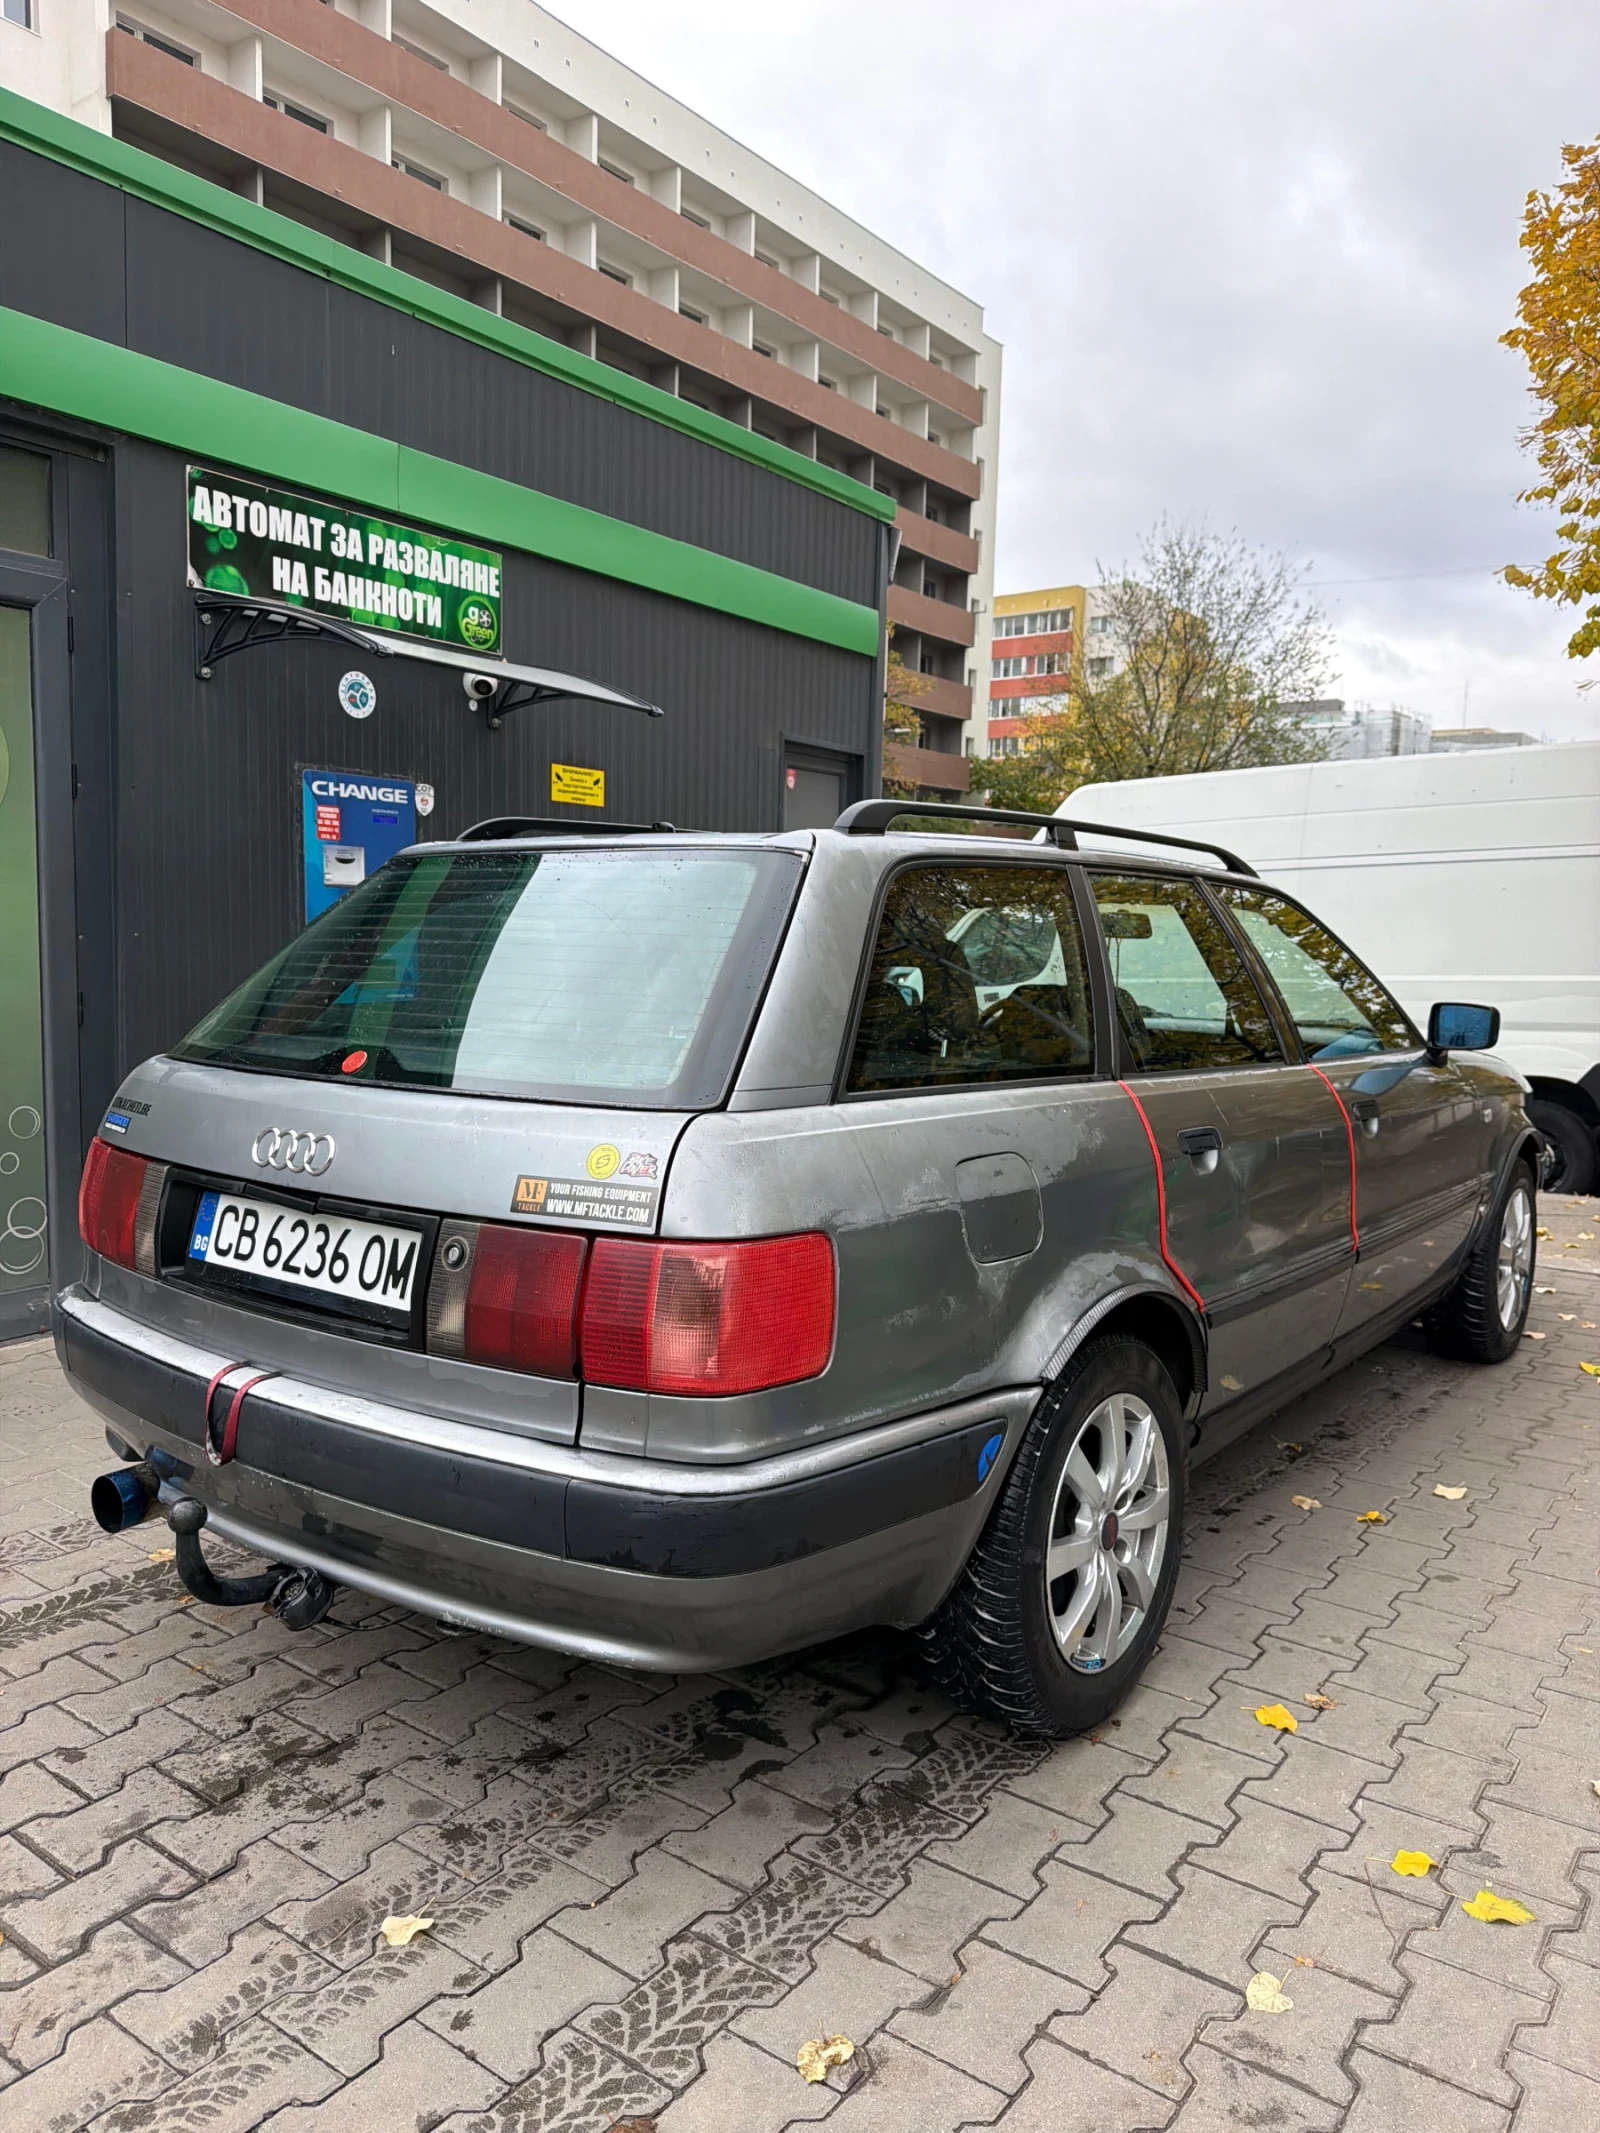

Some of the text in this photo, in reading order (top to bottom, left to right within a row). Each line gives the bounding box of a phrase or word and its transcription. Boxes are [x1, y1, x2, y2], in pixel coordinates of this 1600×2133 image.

[193, 485, 500, 598] АВТОМАТ ЗА РАЗВАЛЯНЕ
[272, 556, 442, 628] НА БАНКНОТИ
[462, 618, 494, 640] Green
[312, 780, 408, 804] CHANGE
[522, 1181, 544, 1200] MF
[550, 1182, 653, 1203] YOUR FISHING EQUIPMENT
[517, 1202, 541, 1212] TACKLE
[546, 1198, 650, 1223] WWW.MFTACKLE.COM
[194, 1234, 209, 1251] BG
[214, 1204, 417, 1300] CB 6236 OM
